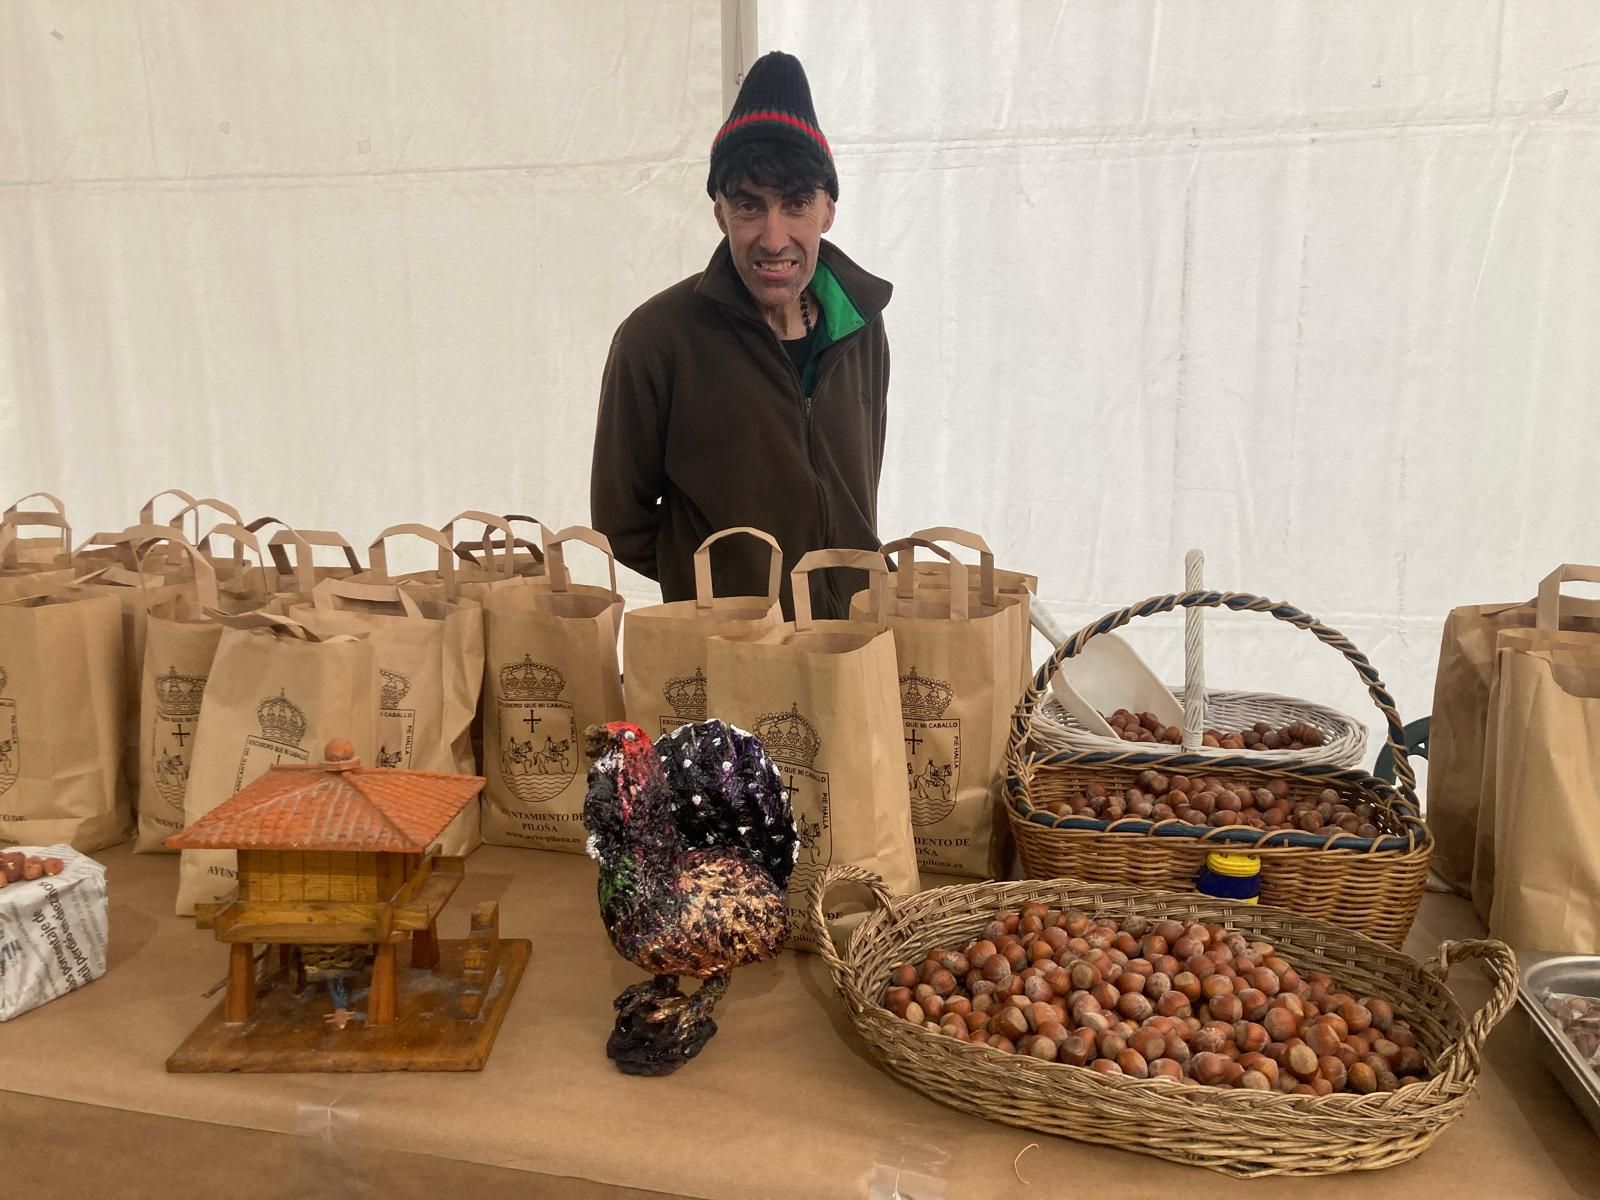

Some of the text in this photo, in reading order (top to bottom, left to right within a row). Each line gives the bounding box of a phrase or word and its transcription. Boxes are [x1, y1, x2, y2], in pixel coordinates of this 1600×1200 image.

[404, 735, 412, 756] HALLA
[783, 766, 797, 775] QUE
[797, 768, 805, 776] MI
[822, 805, 830, 830] HALLA
[521, 822, 559, 833] PILOÑA
[955, 838, 971, 847] DE
[32, 908, 46, 923] de
[60, 918, 70, 934] en
[41, 922, 73, 977] porcentaje
